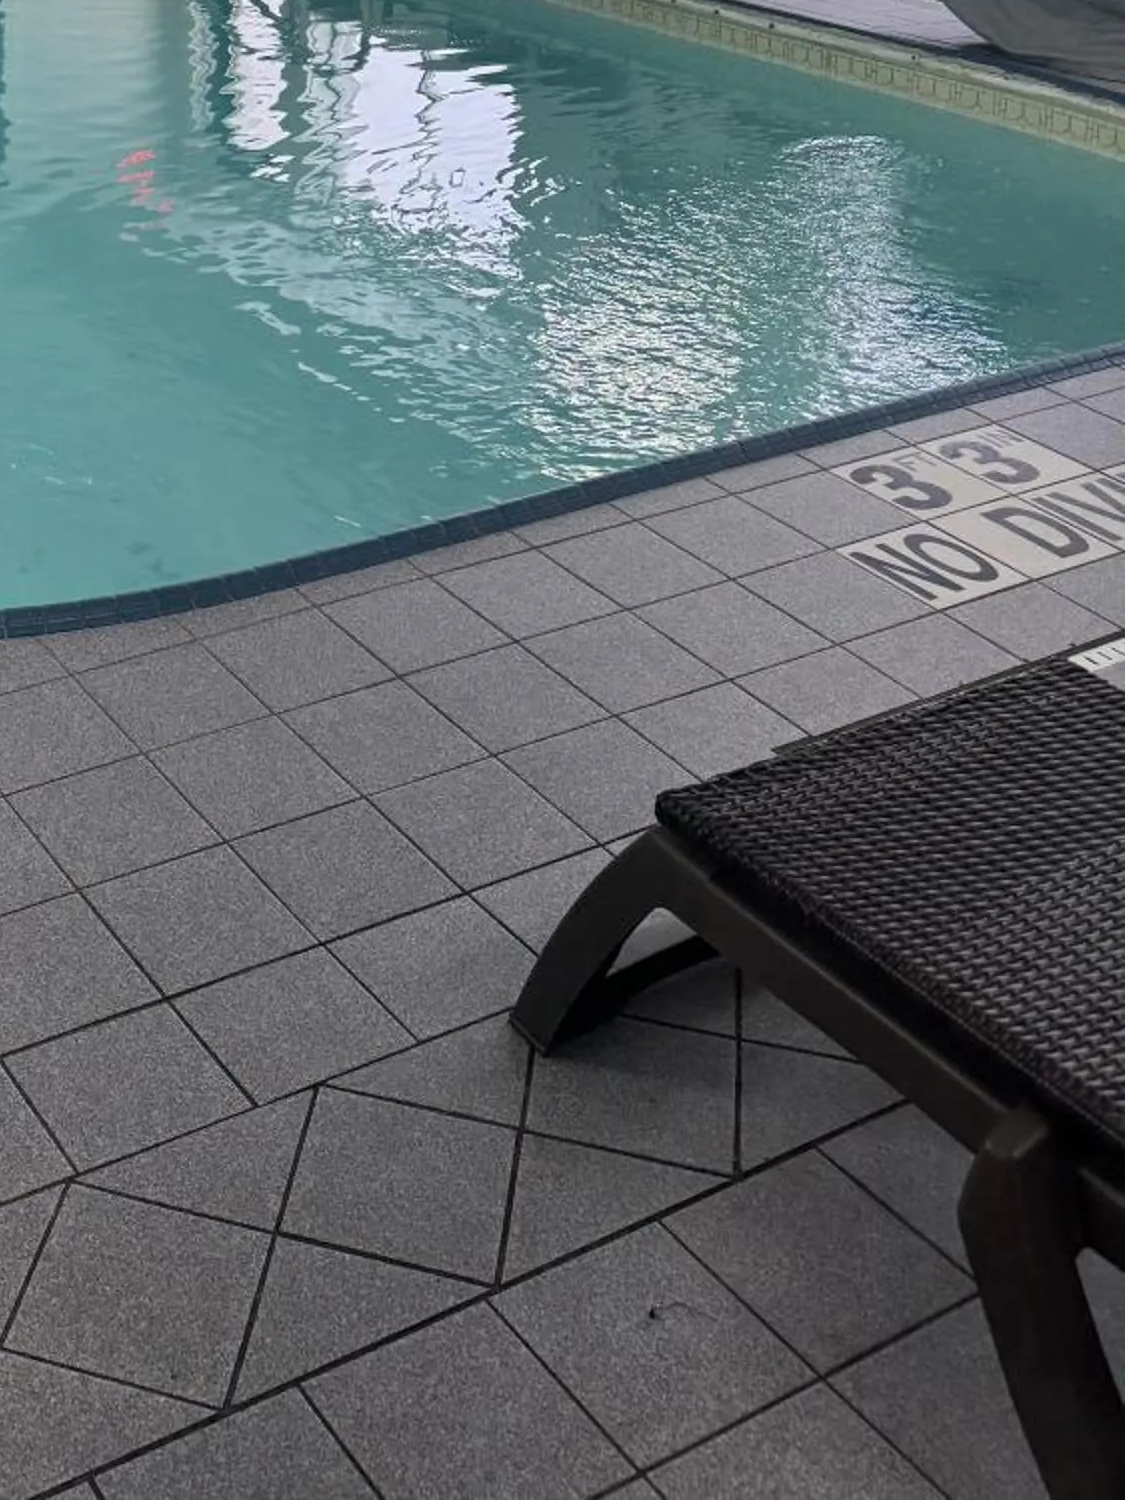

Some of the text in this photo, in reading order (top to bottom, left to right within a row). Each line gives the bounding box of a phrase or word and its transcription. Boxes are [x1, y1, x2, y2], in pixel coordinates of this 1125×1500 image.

[850, 464, 953, 510] 3
[939, 440, 1041, 485] 3
[848, 533, 1000, 601] NO
